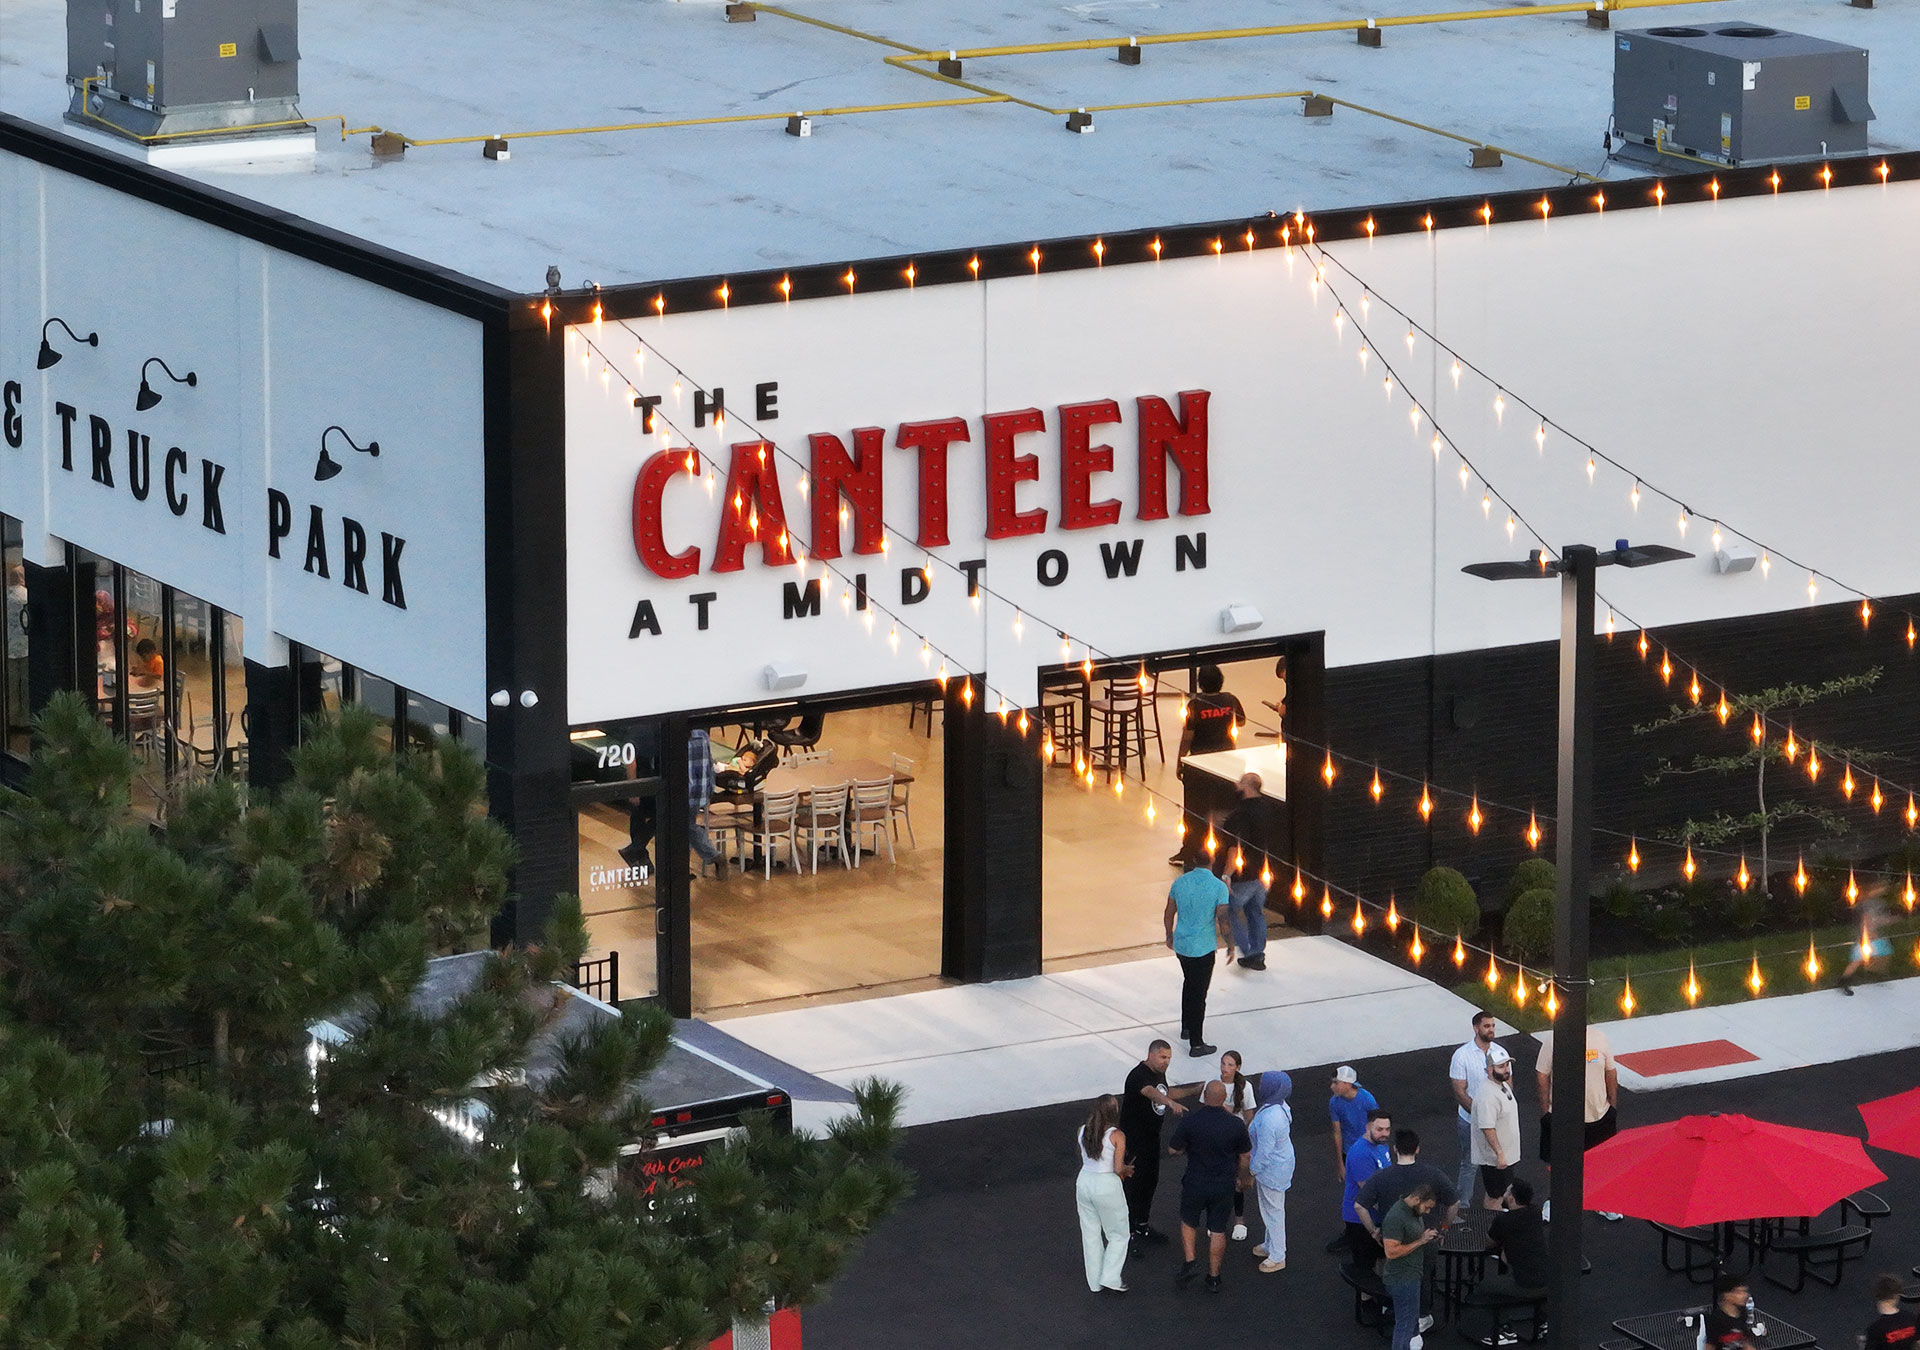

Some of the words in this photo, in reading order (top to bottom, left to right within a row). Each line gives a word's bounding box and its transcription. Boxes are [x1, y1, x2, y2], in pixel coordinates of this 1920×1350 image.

[634, 381, 779, 436] THE
[3, 380, 23, 448] &
[55, 401, 227, 536] TRUCK
[267, 487, 408, 611] PARK
[631, 389, 1212, 580] CANTEEN
[628, 592, 717, 639] AT
[783, 532, 1208, 621] MIDTOWN
[595, 742, 636, 769] 720
[590, 865, 649, 886] CANTEEN
